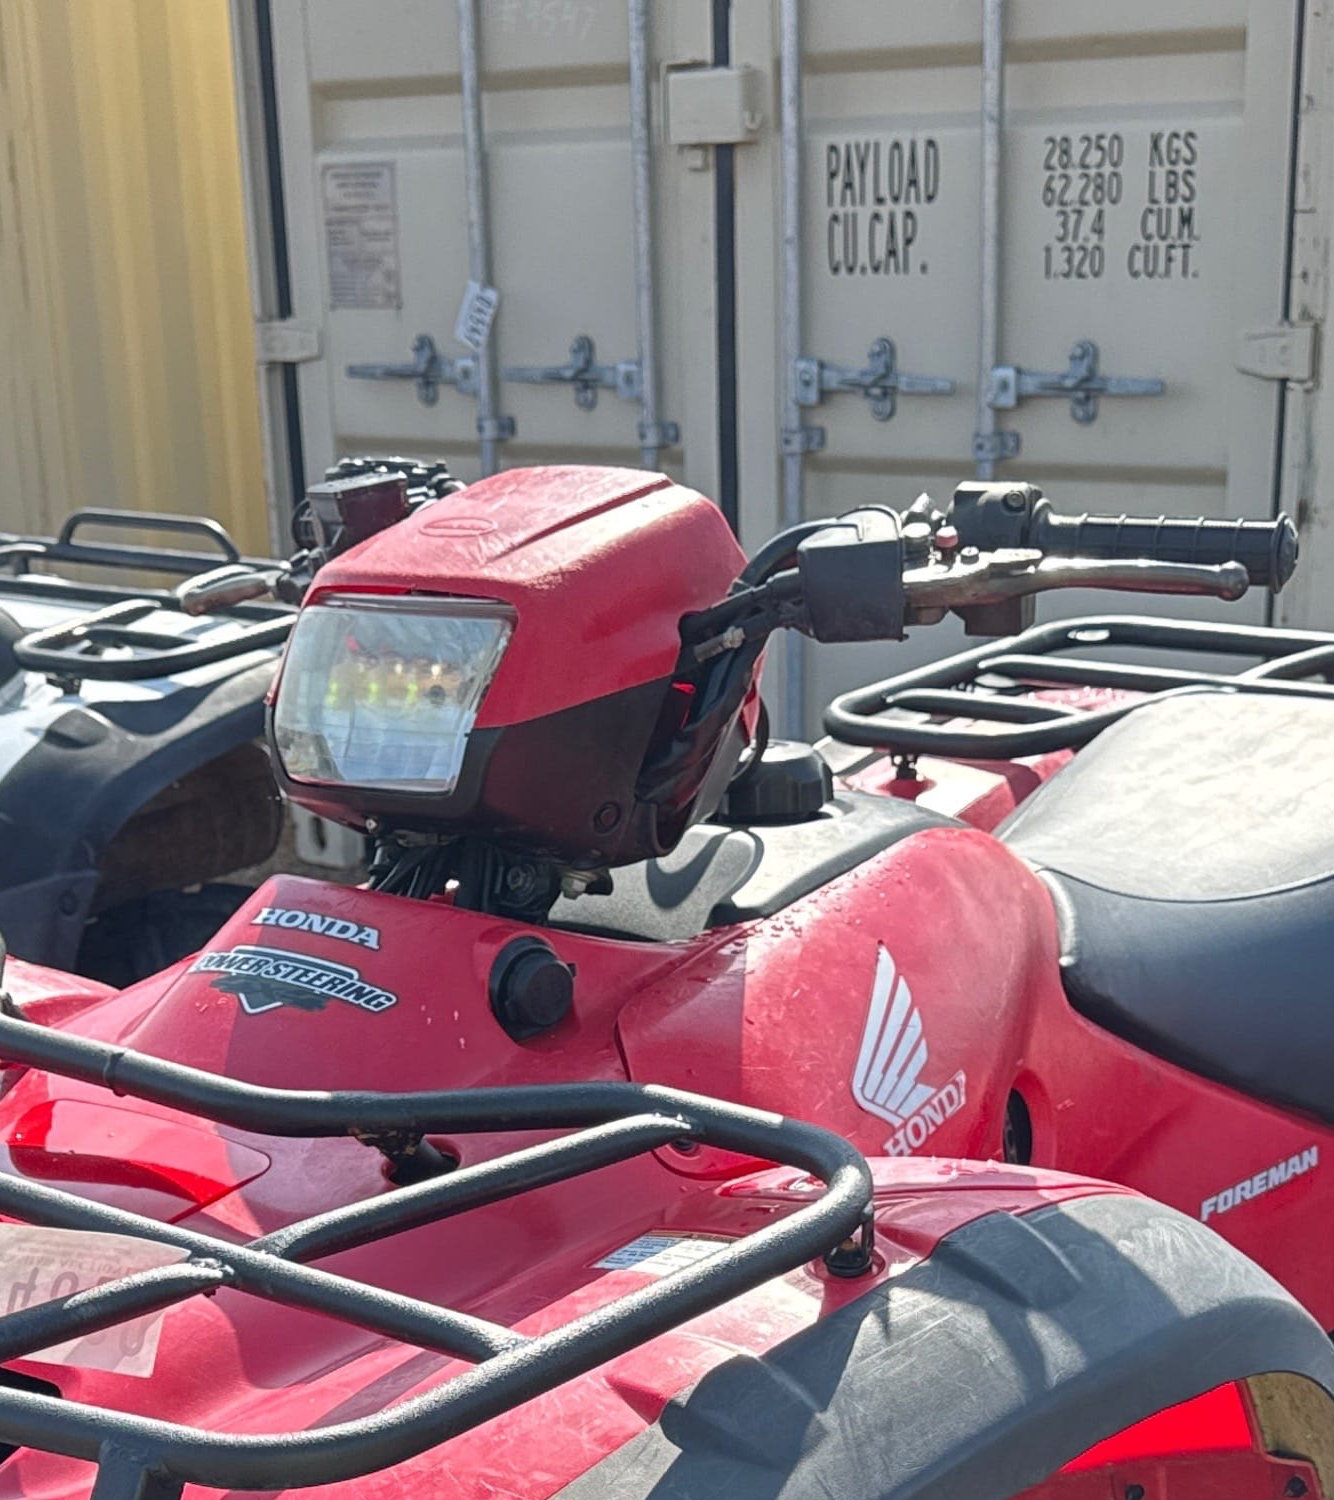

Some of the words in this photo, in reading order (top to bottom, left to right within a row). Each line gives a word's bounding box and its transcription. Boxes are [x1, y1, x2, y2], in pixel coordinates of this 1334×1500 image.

[1043, 133, 1124, 171] 28.250
[1147, 130, 1199, 168] KGS
[826, 138, 940, 208] PAYLOAD
[1042, 171, 1123, 207] 62.280
[1147, 169, 1197, 203] LBS
[827, 210, 928, 276] CU.CAP.
[1055, 209, 1105, 243] 37.4
[1043, 245, 1105, 279] 1.320
[251, 907, 381, 950] HONDA
[266, 961, 395, 1009] STEERING
[1200, 1144, 1318, 1222] FOREMAN
